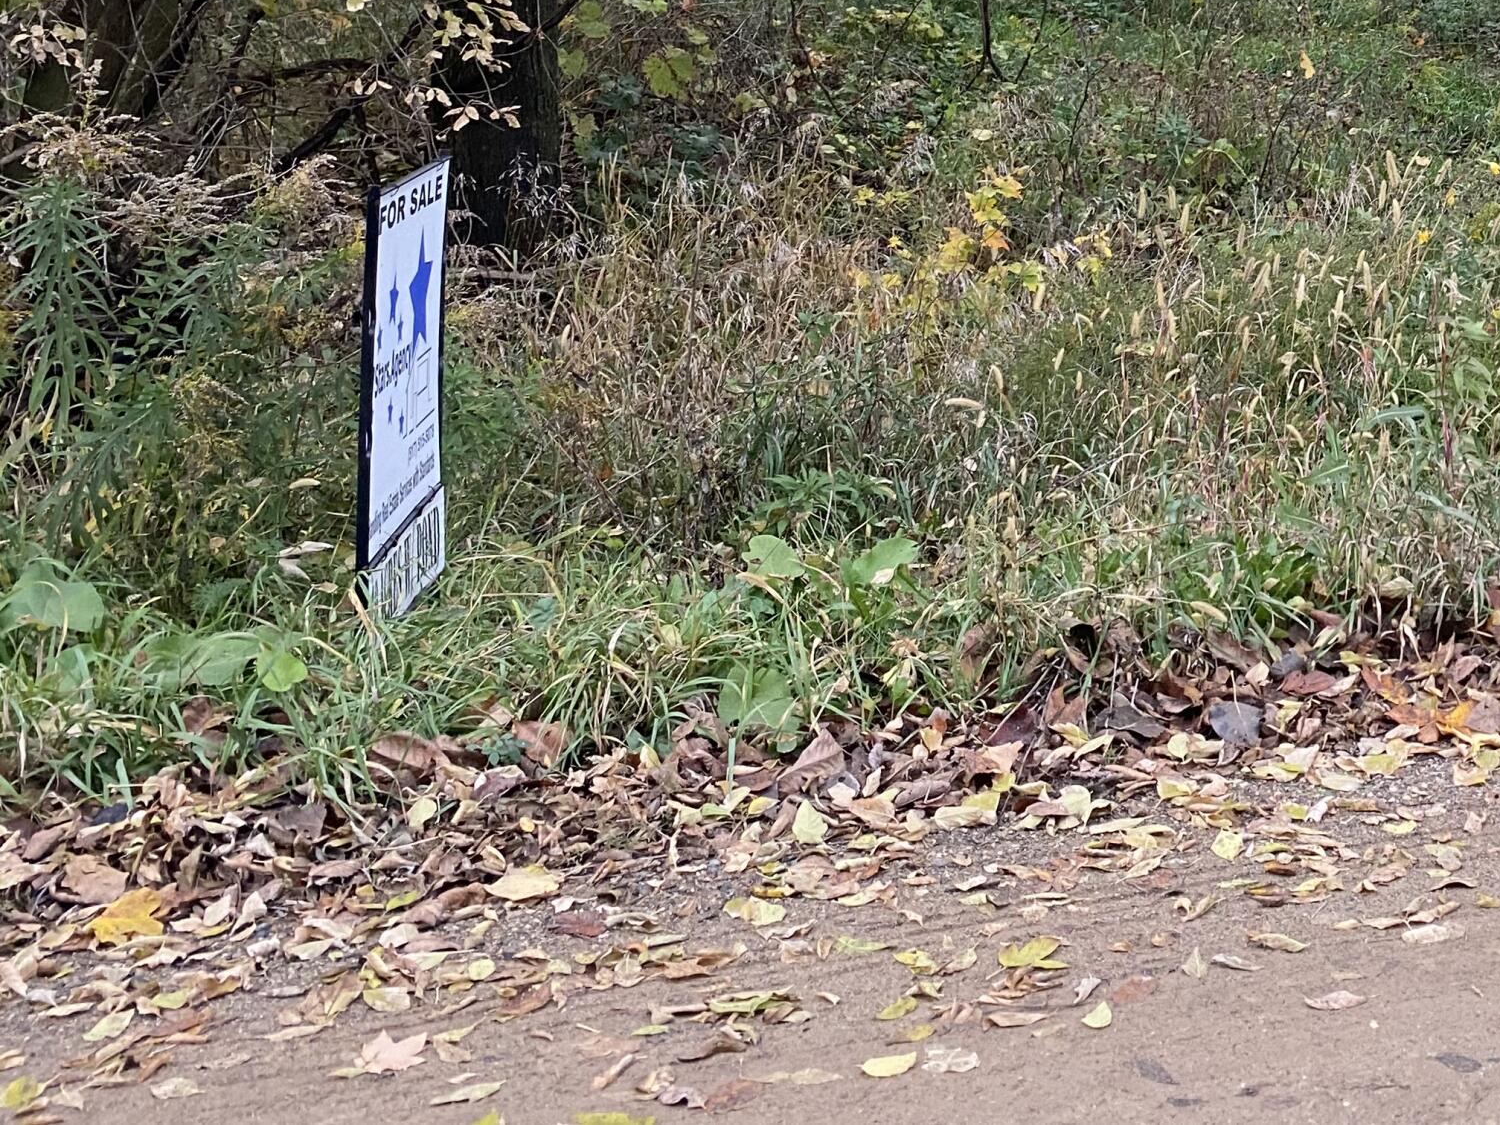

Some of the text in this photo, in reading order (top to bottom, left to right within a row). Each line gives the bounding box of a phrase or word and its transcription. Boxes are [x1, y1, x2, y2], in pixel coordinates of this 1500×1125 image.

[379, 174, 443, 235] FOR SALE
[391, 340, 413, 388] Agency
